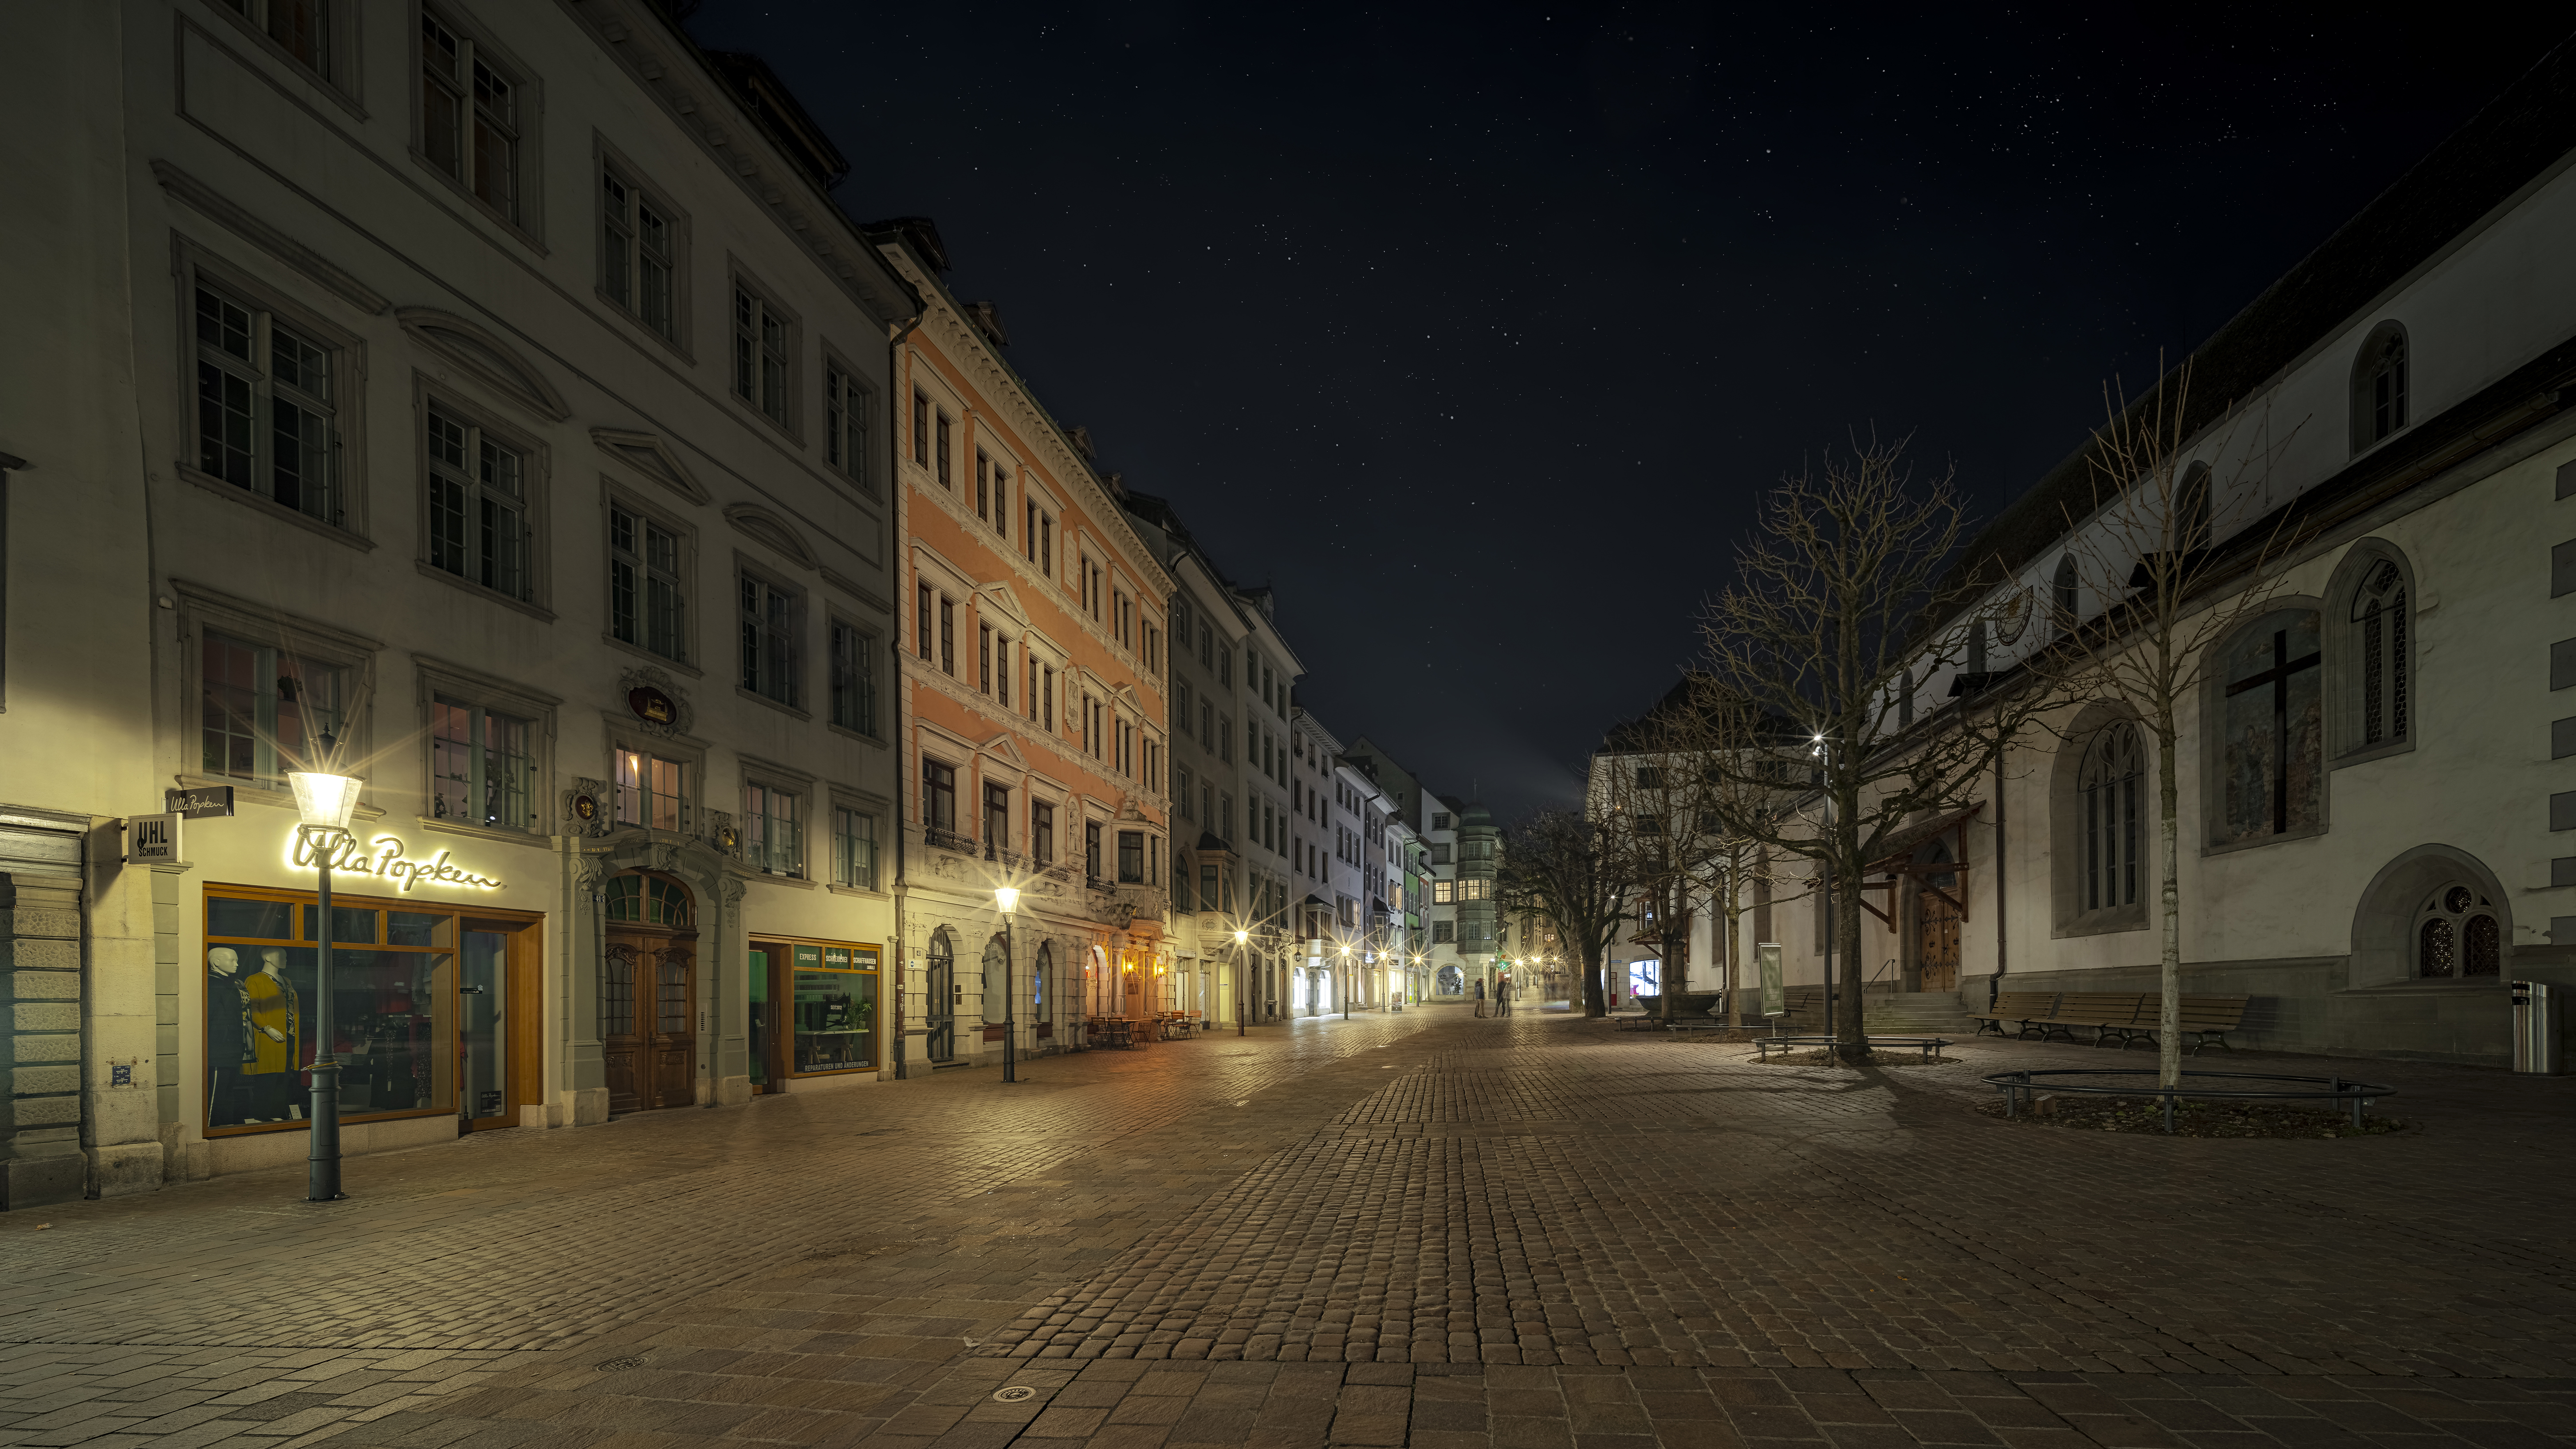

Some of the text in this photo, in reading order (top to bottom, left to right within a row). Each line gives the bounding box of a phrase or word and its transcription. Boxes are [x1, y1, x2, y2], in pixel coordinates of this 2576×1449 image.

[171, 794, 224, 814] Ulla Popken
[138, 821, 168, 844] UHL
[138, 847, 168, 857] SCHMUCK
[375, 837, 502, 891] Popken
[805, 1063, 834, 1072] REPARATUREN
